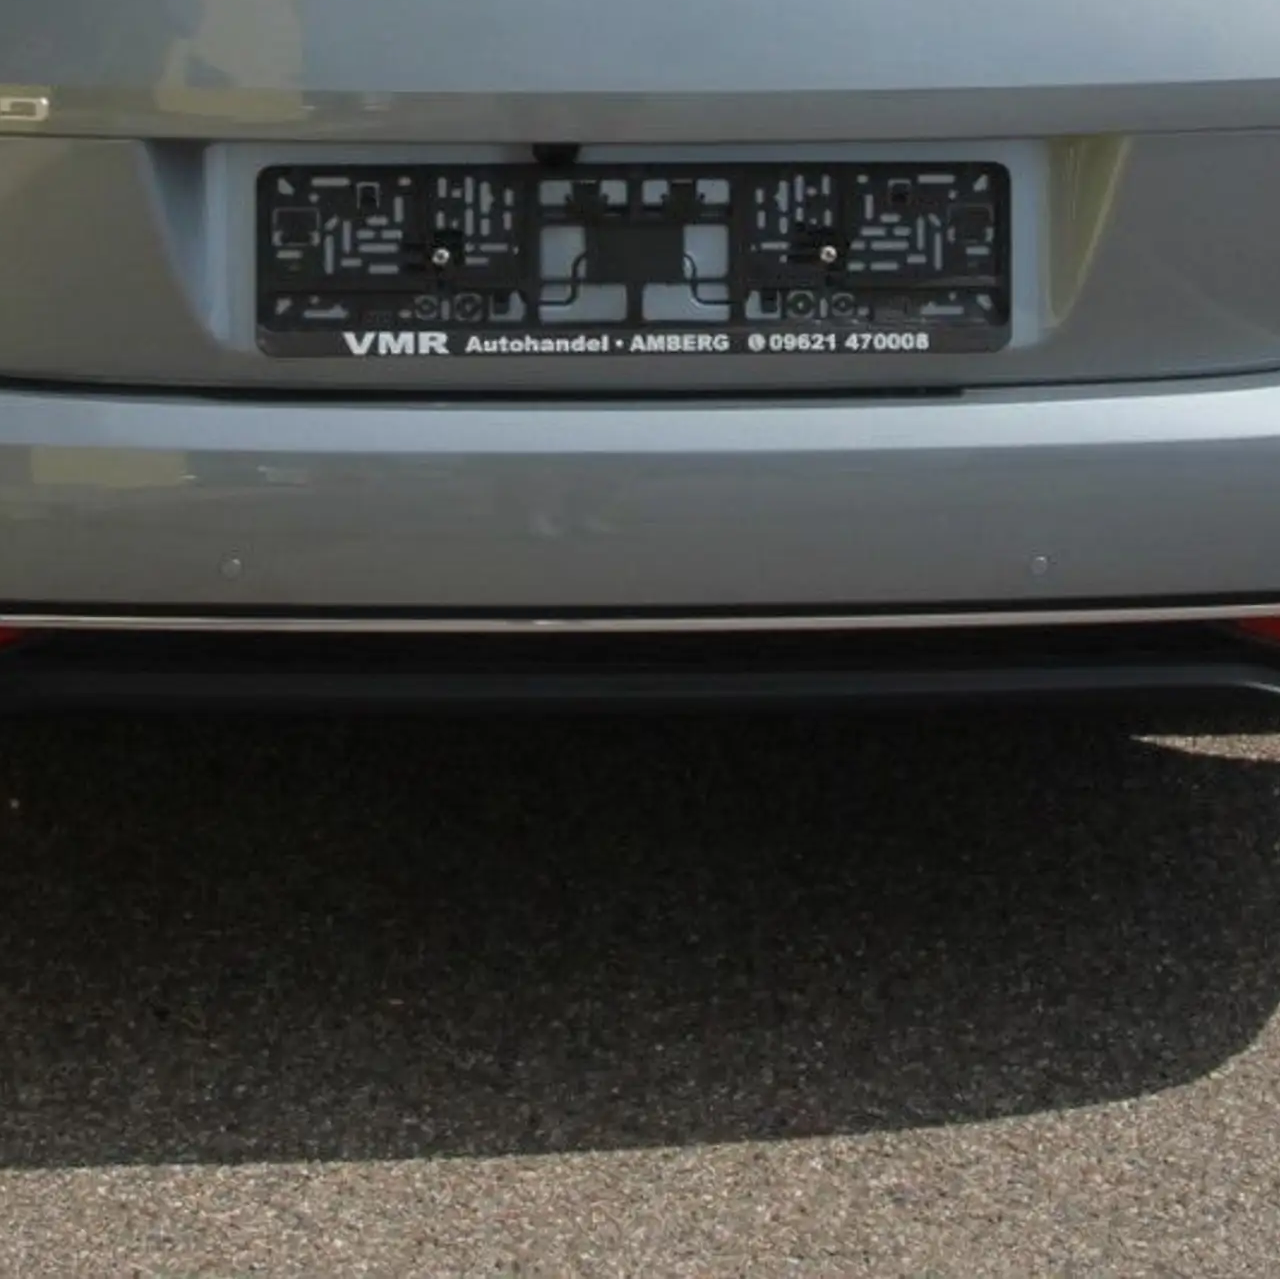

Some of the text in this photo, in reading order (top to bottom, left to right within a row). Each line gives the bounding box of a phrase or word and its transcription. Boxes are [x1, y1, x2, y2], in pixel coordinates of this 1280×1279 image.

[343, 331, 449, 355] VMR
[465, 335, 609, 353] Autohandel
[630, 334, 729, 352] AMBERG
[770, 333, 836, 351] 09621
